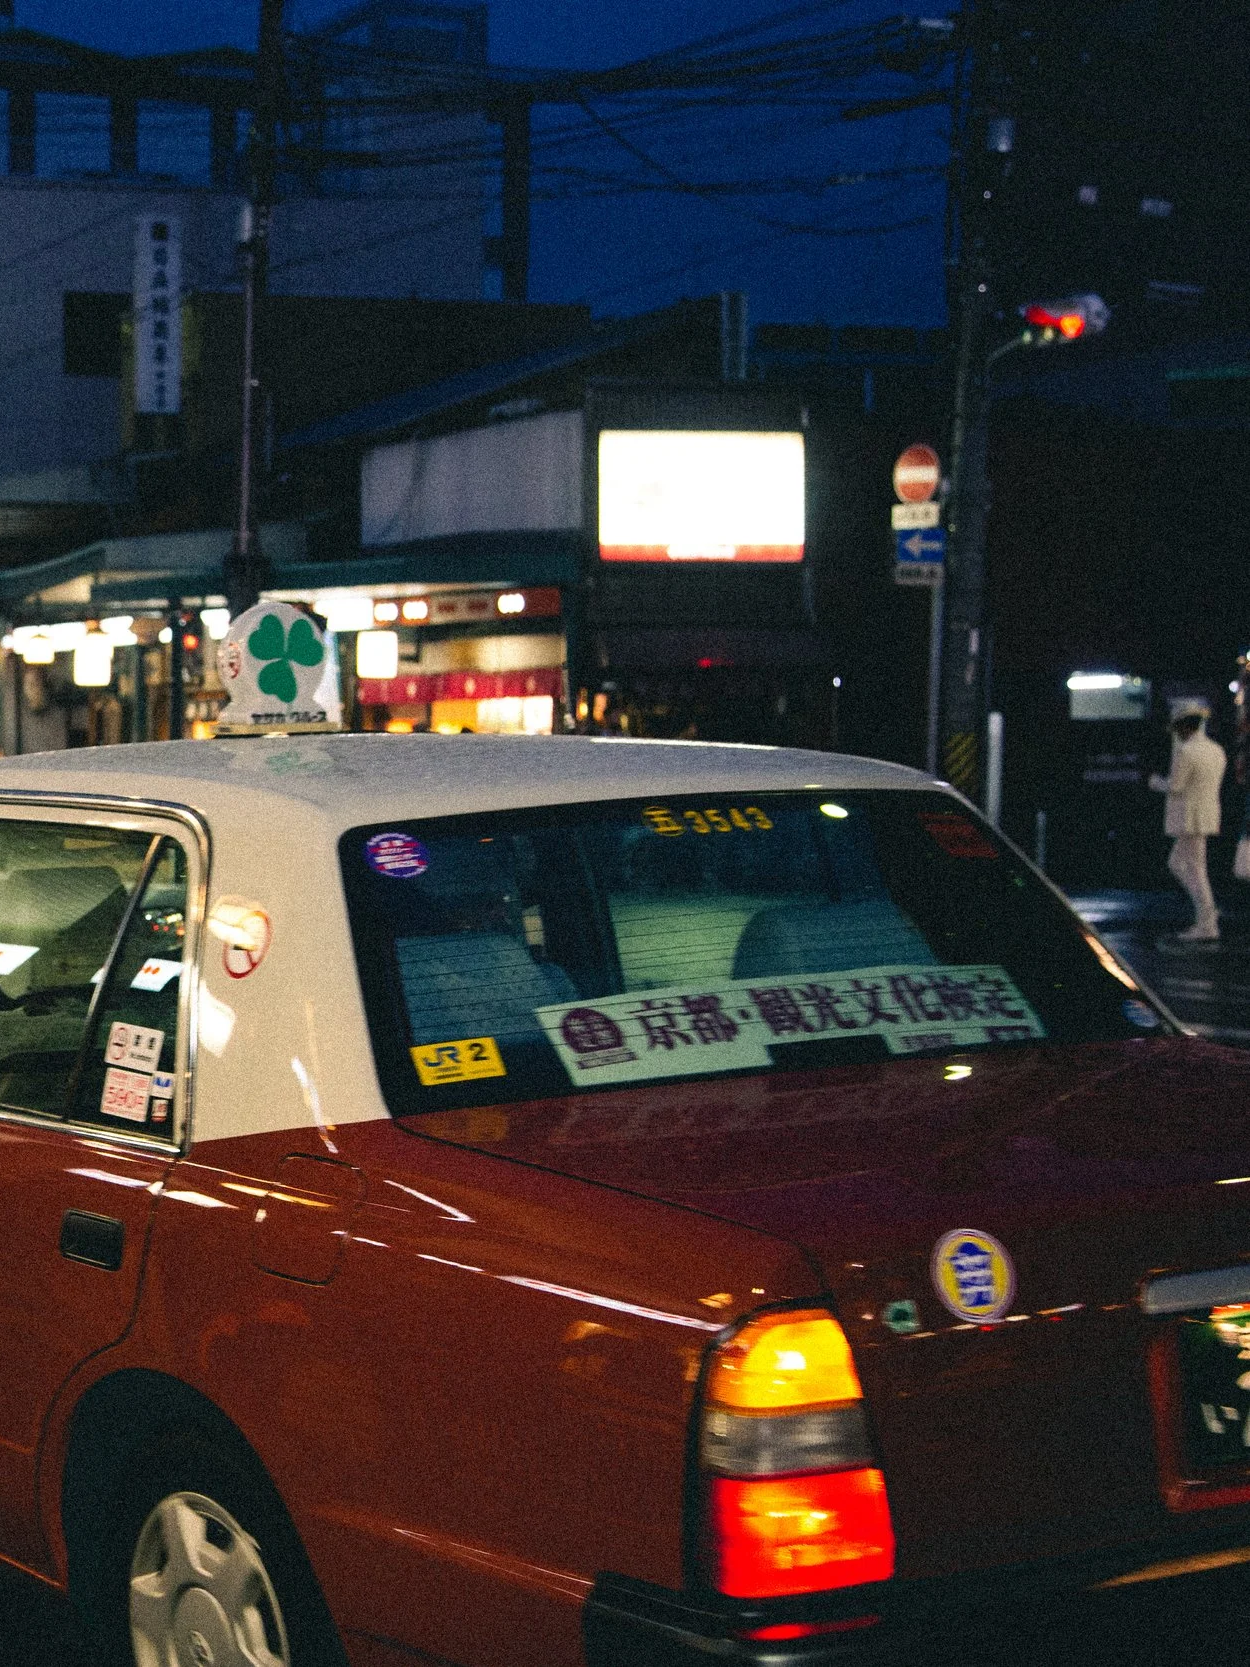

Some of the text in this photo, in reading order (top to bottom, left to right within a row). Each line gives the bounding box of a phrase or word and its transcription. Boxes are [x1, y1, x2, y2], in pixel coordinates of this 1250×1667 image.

[682, 806, 774, 834] 3543
[423, 1042, 490, 1067] JR 2
